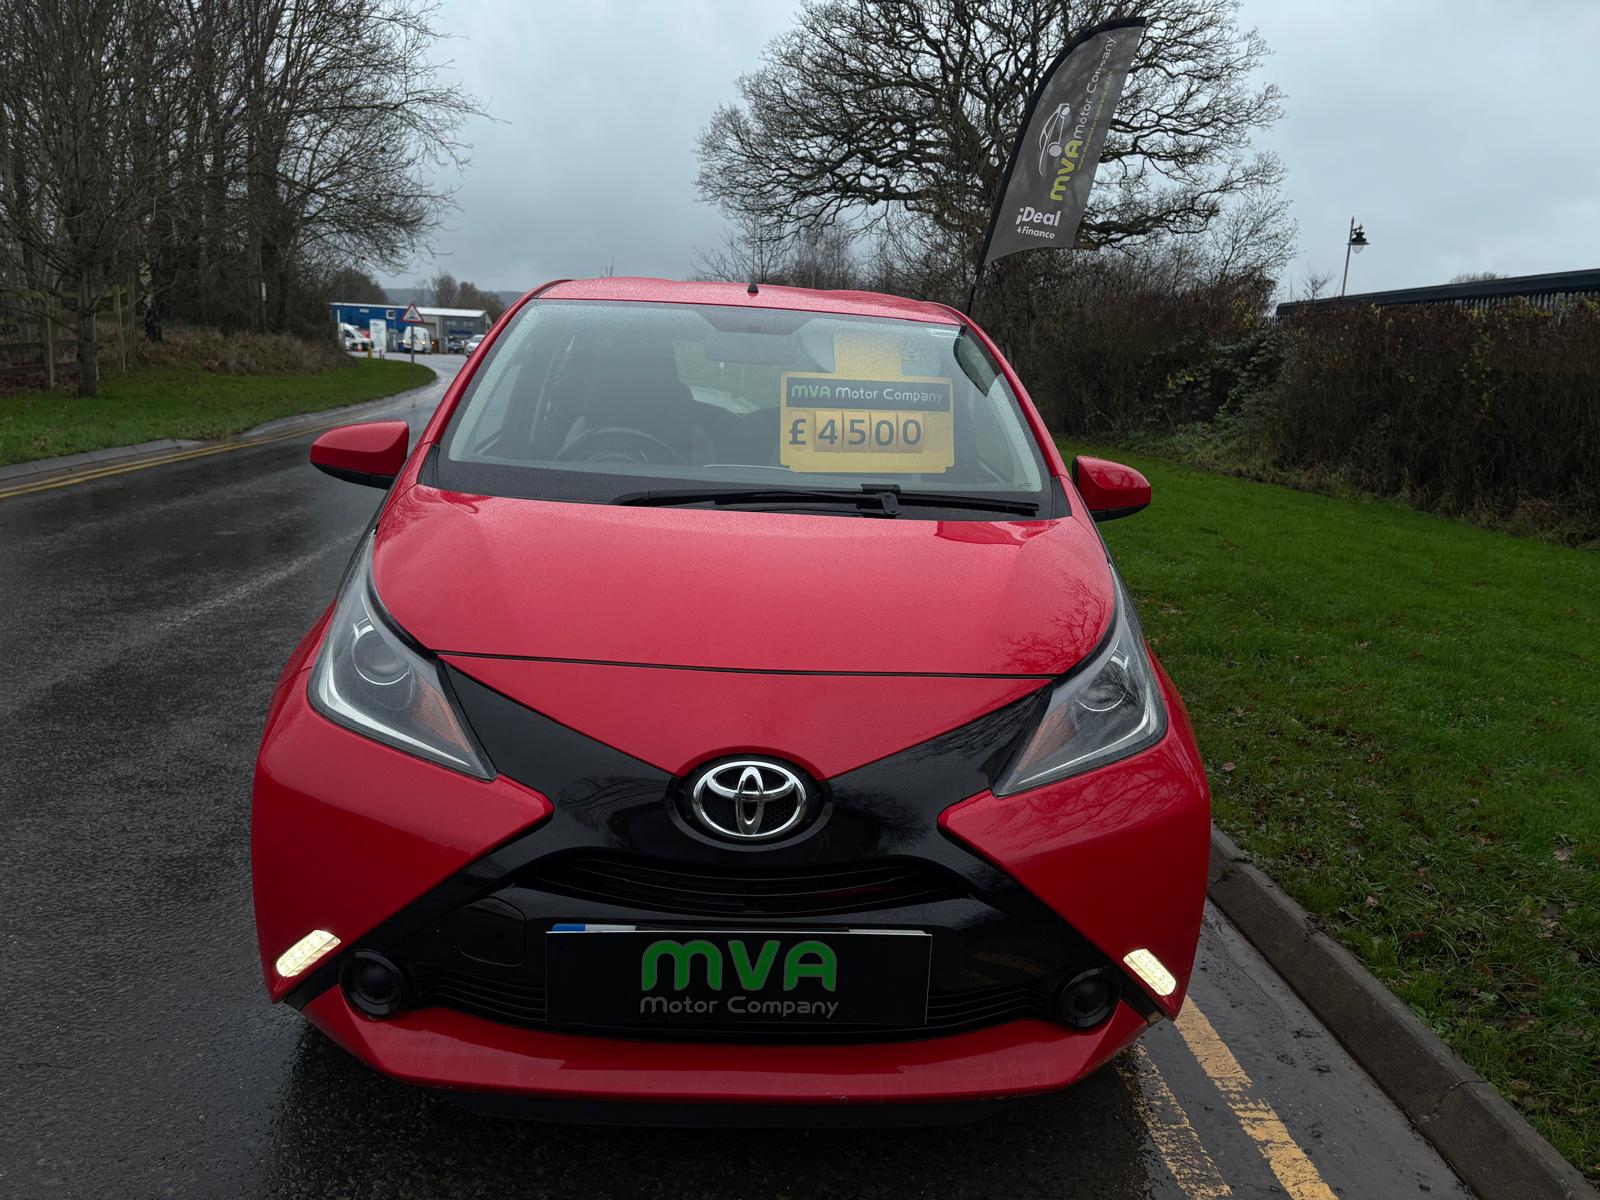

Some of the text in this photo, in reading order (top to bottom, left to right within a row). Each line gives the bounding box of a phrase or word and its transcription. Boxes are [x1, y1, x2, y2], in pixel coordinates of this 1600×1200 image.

[1073, 98, 1093, 139] Motor
[1015, 206, 1062, 227] iDeal
[791, 384, 943, 405] MVA Motor Company
[641, 939, 838, 992] MVA
[639, 996, 840, 1019] Motor Company
